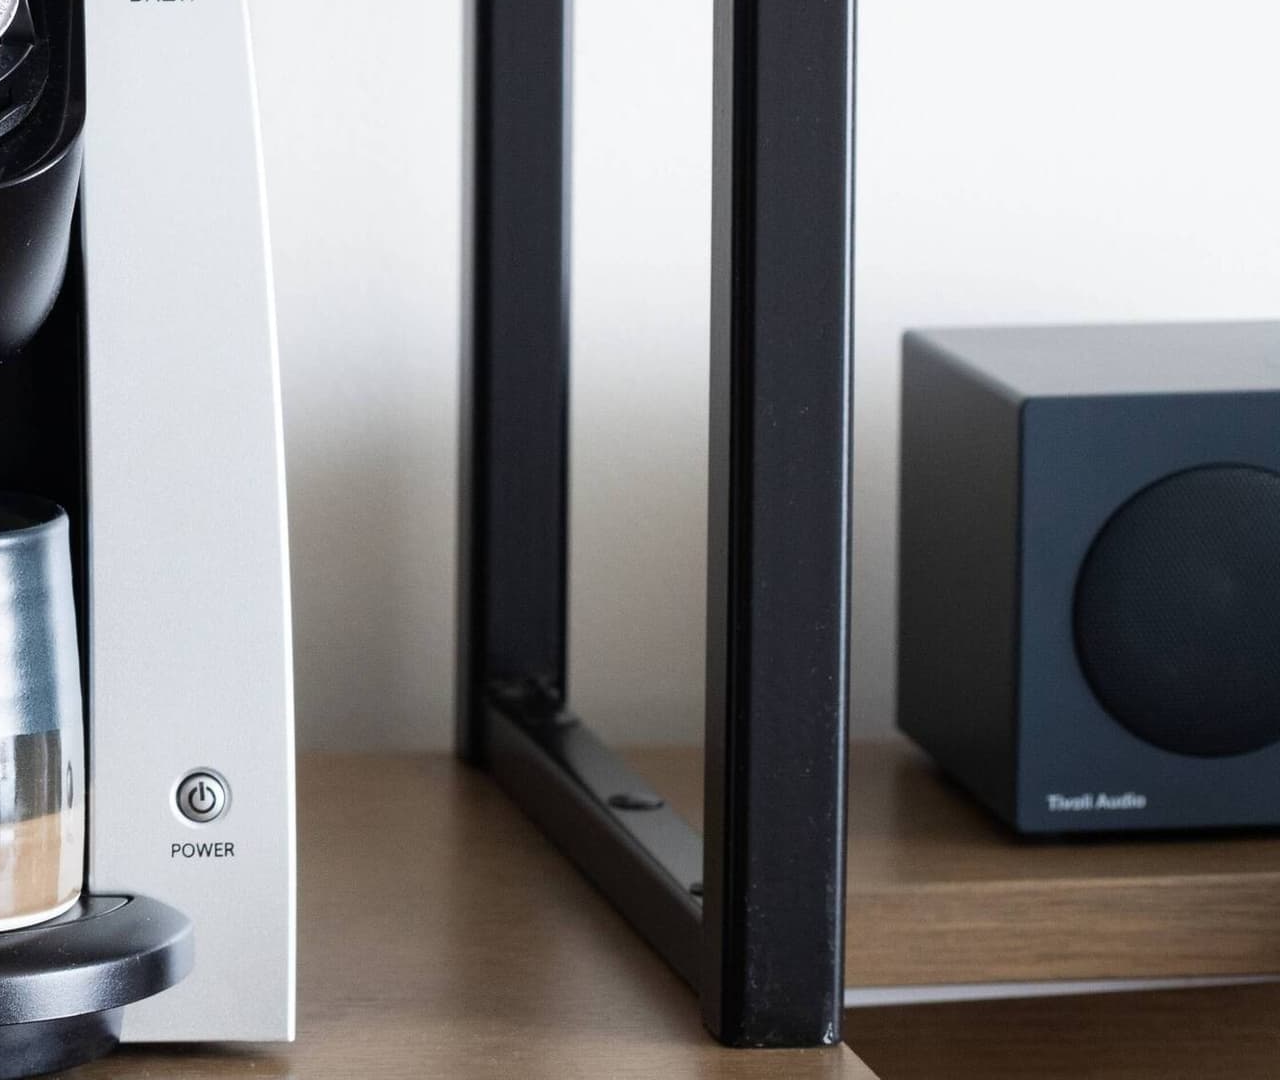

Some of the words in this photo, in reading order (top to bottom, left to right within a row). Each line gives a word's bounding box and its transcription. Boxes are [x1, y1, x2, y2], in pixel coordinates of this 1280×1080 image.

[1046, 793, 1093, 811] Tivoli
[1094, 791, 1147, 810] Audio
[170, 842, 235, 858] POWER
